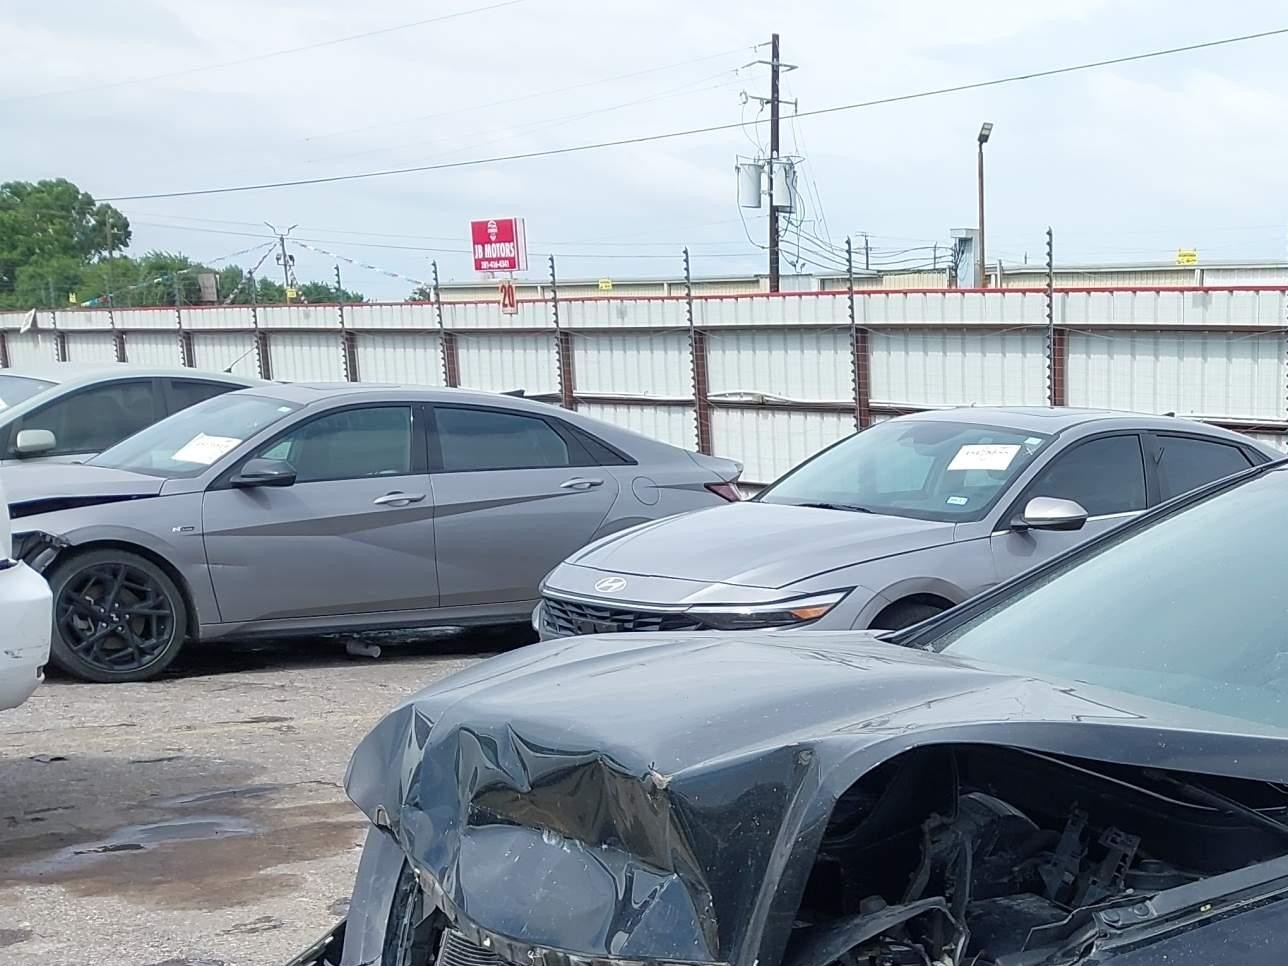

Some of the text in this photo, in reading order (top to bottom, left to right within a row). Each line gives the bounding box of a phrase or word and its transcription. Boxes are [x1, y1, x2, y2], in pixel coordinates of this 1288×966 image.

[474, 242, 515, 259] JB MOTORS
[500, 284, 515, 308] 20
